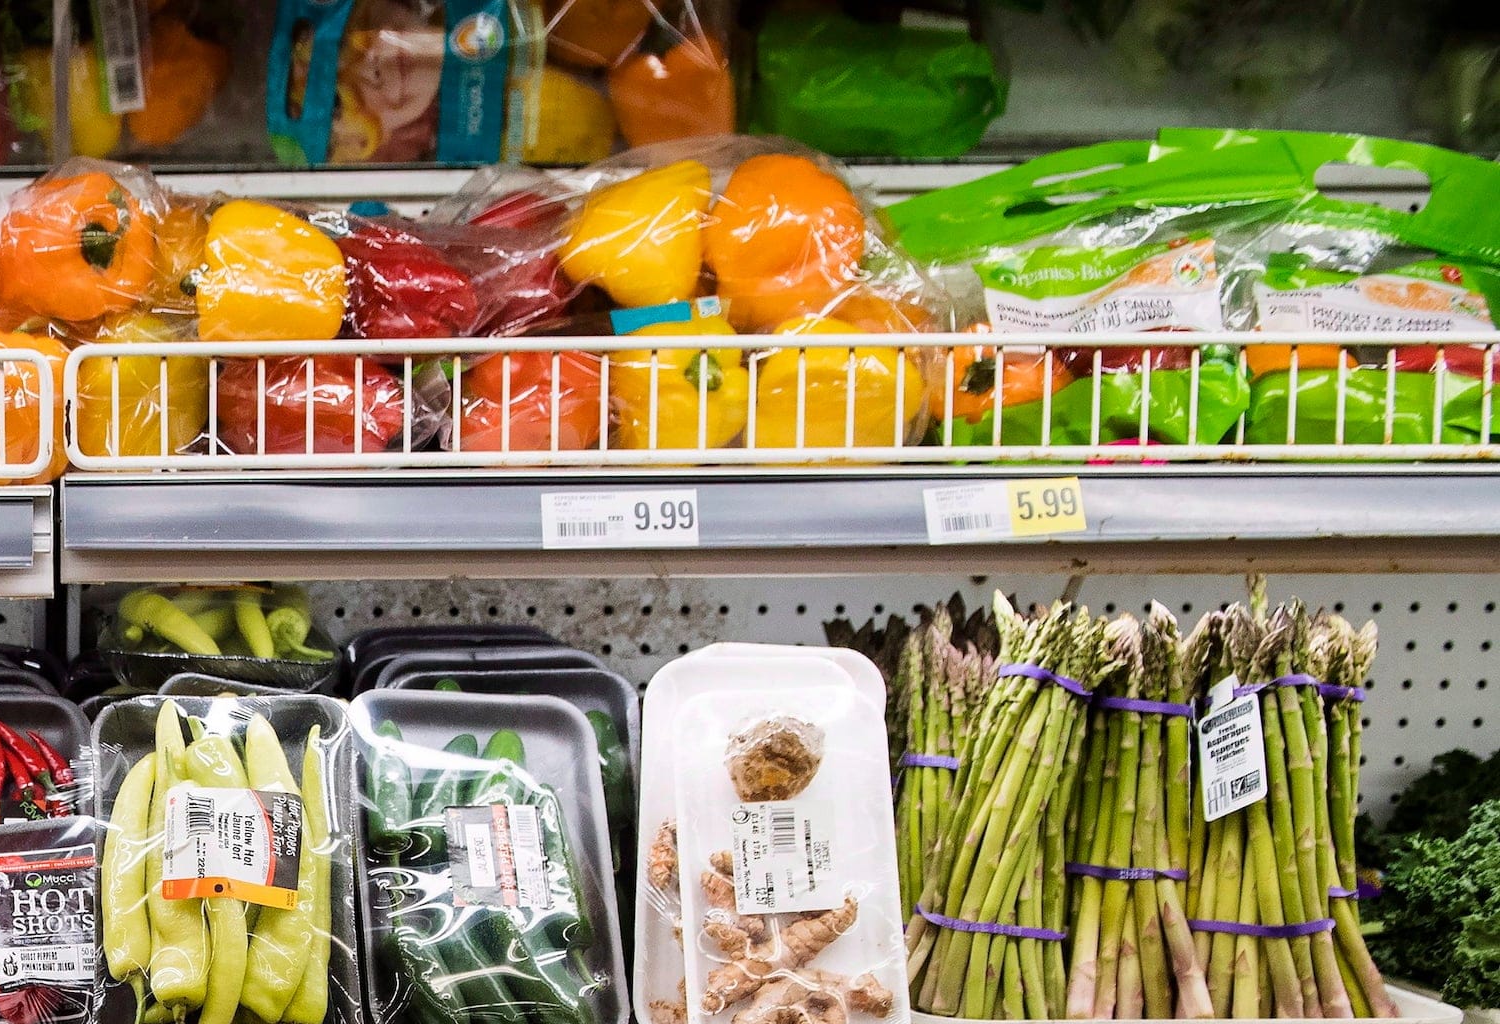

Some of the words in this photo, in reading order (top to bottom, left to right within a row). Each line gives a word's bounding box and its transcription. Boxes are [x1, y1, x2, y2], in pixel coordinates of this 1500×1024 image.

[999, 265, 1076, 287] Organics
[634, 500, 695, 531] 9.99
[1016, 487, 1078, 521] 5.99
[1207, 723, 1252, 749] Asparagus
[1210, 735, 1250, 758] Asperges
[272, 795, 286, 834] Piments
[286, 799, 301, 818] Hot
[232, 811, 244, 841] Jaune
[244, 814, 256, 846] Yellow
[270, 834, 283, 857] Fort
[284, 820, 300, 857] Peppers
[495, 816, 511, 864] PEPPERS
[196, 857, 206, 879] 226G
[243, 848, 255, 867] Hot
[42, 872, 77, 884] Mucci
[502, 868, 514, 892] HOT
[11, 888, 94, 917] HOT
[12, 914, 95, 936] SHOTS
[20, 953, 37, 961] GHOST
[37, 952, 58, 961] PEPPERS
[81, 947, 90, 955] 50
